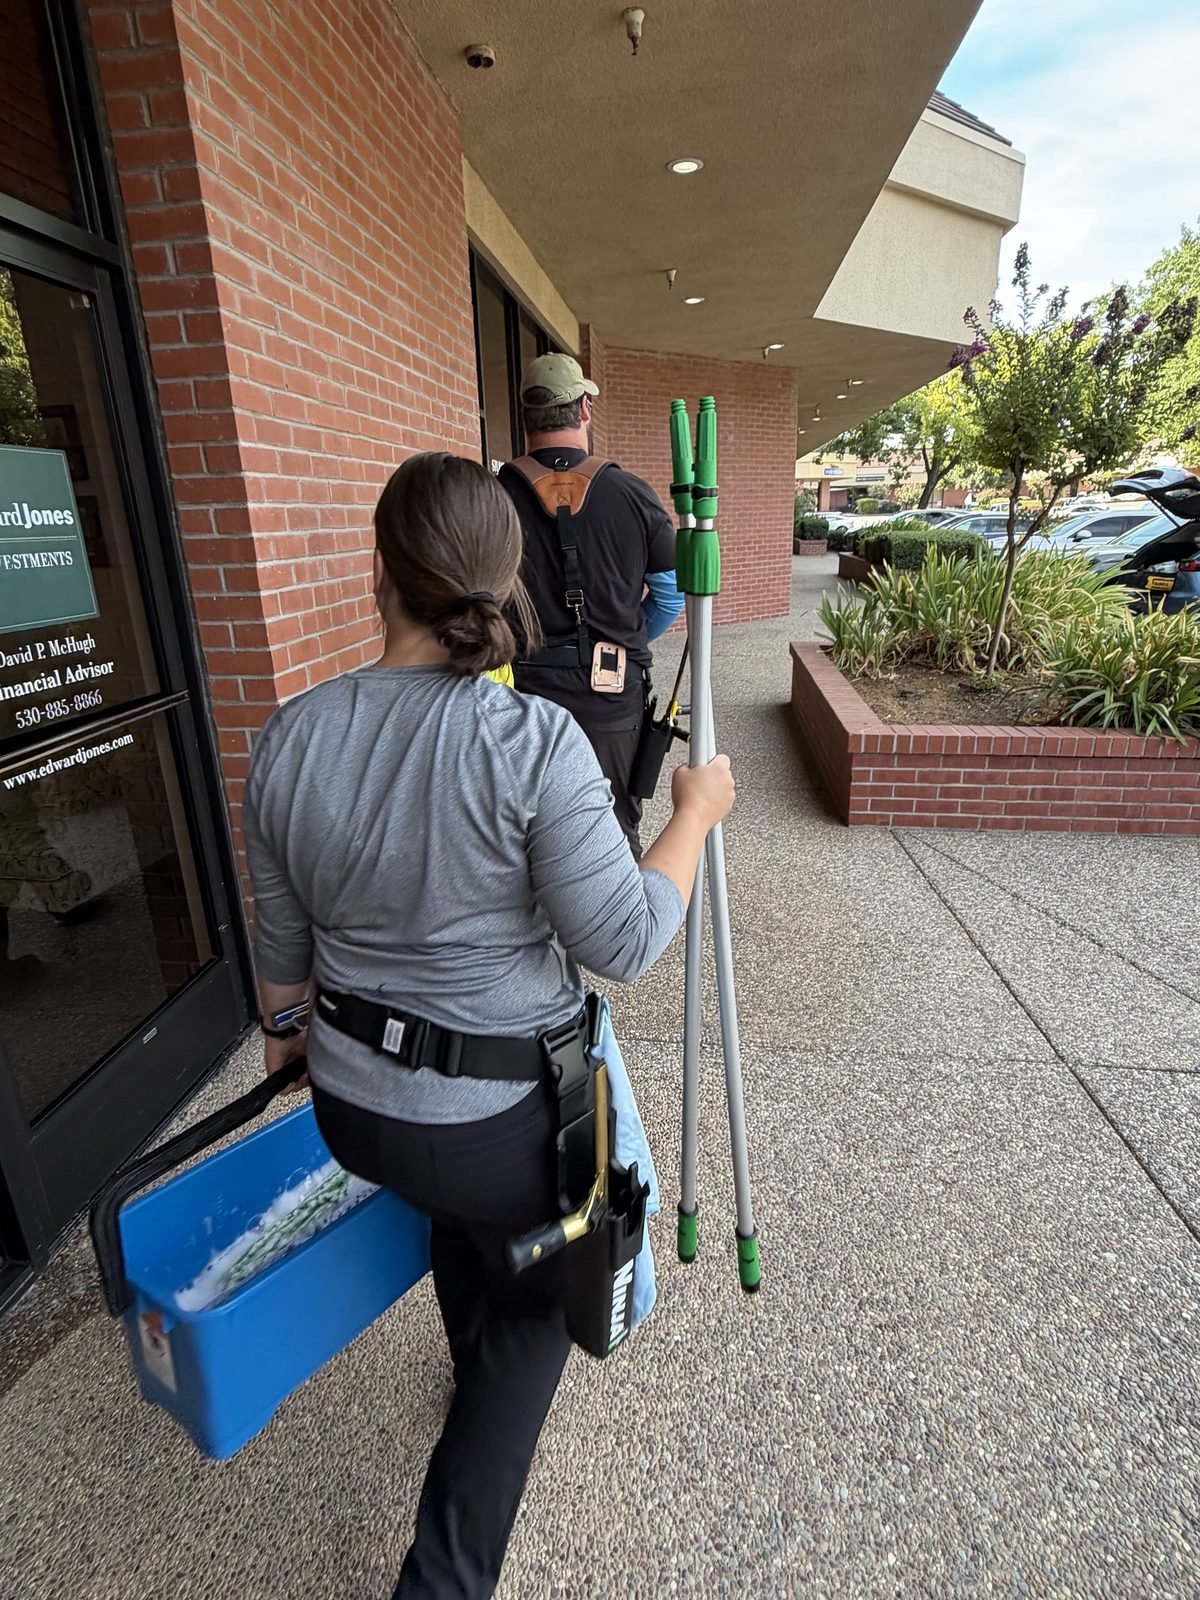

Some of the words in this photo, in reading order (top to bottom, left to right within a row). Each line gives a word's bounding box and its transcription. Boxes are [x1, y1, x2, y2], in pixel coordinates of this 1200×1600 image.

[0, 551, 73, 570] ESTMENTS
[35, 642, 46, 660] P.
[48, 633, 96, 655] McHugh
[65, 661, 114, 684] Advisor
[15, 689, 103, 729] 530-885-8866
[3, 734, 134, 790] www.edwardjones.com
[610, 1258, 634, 1342] NINJA
